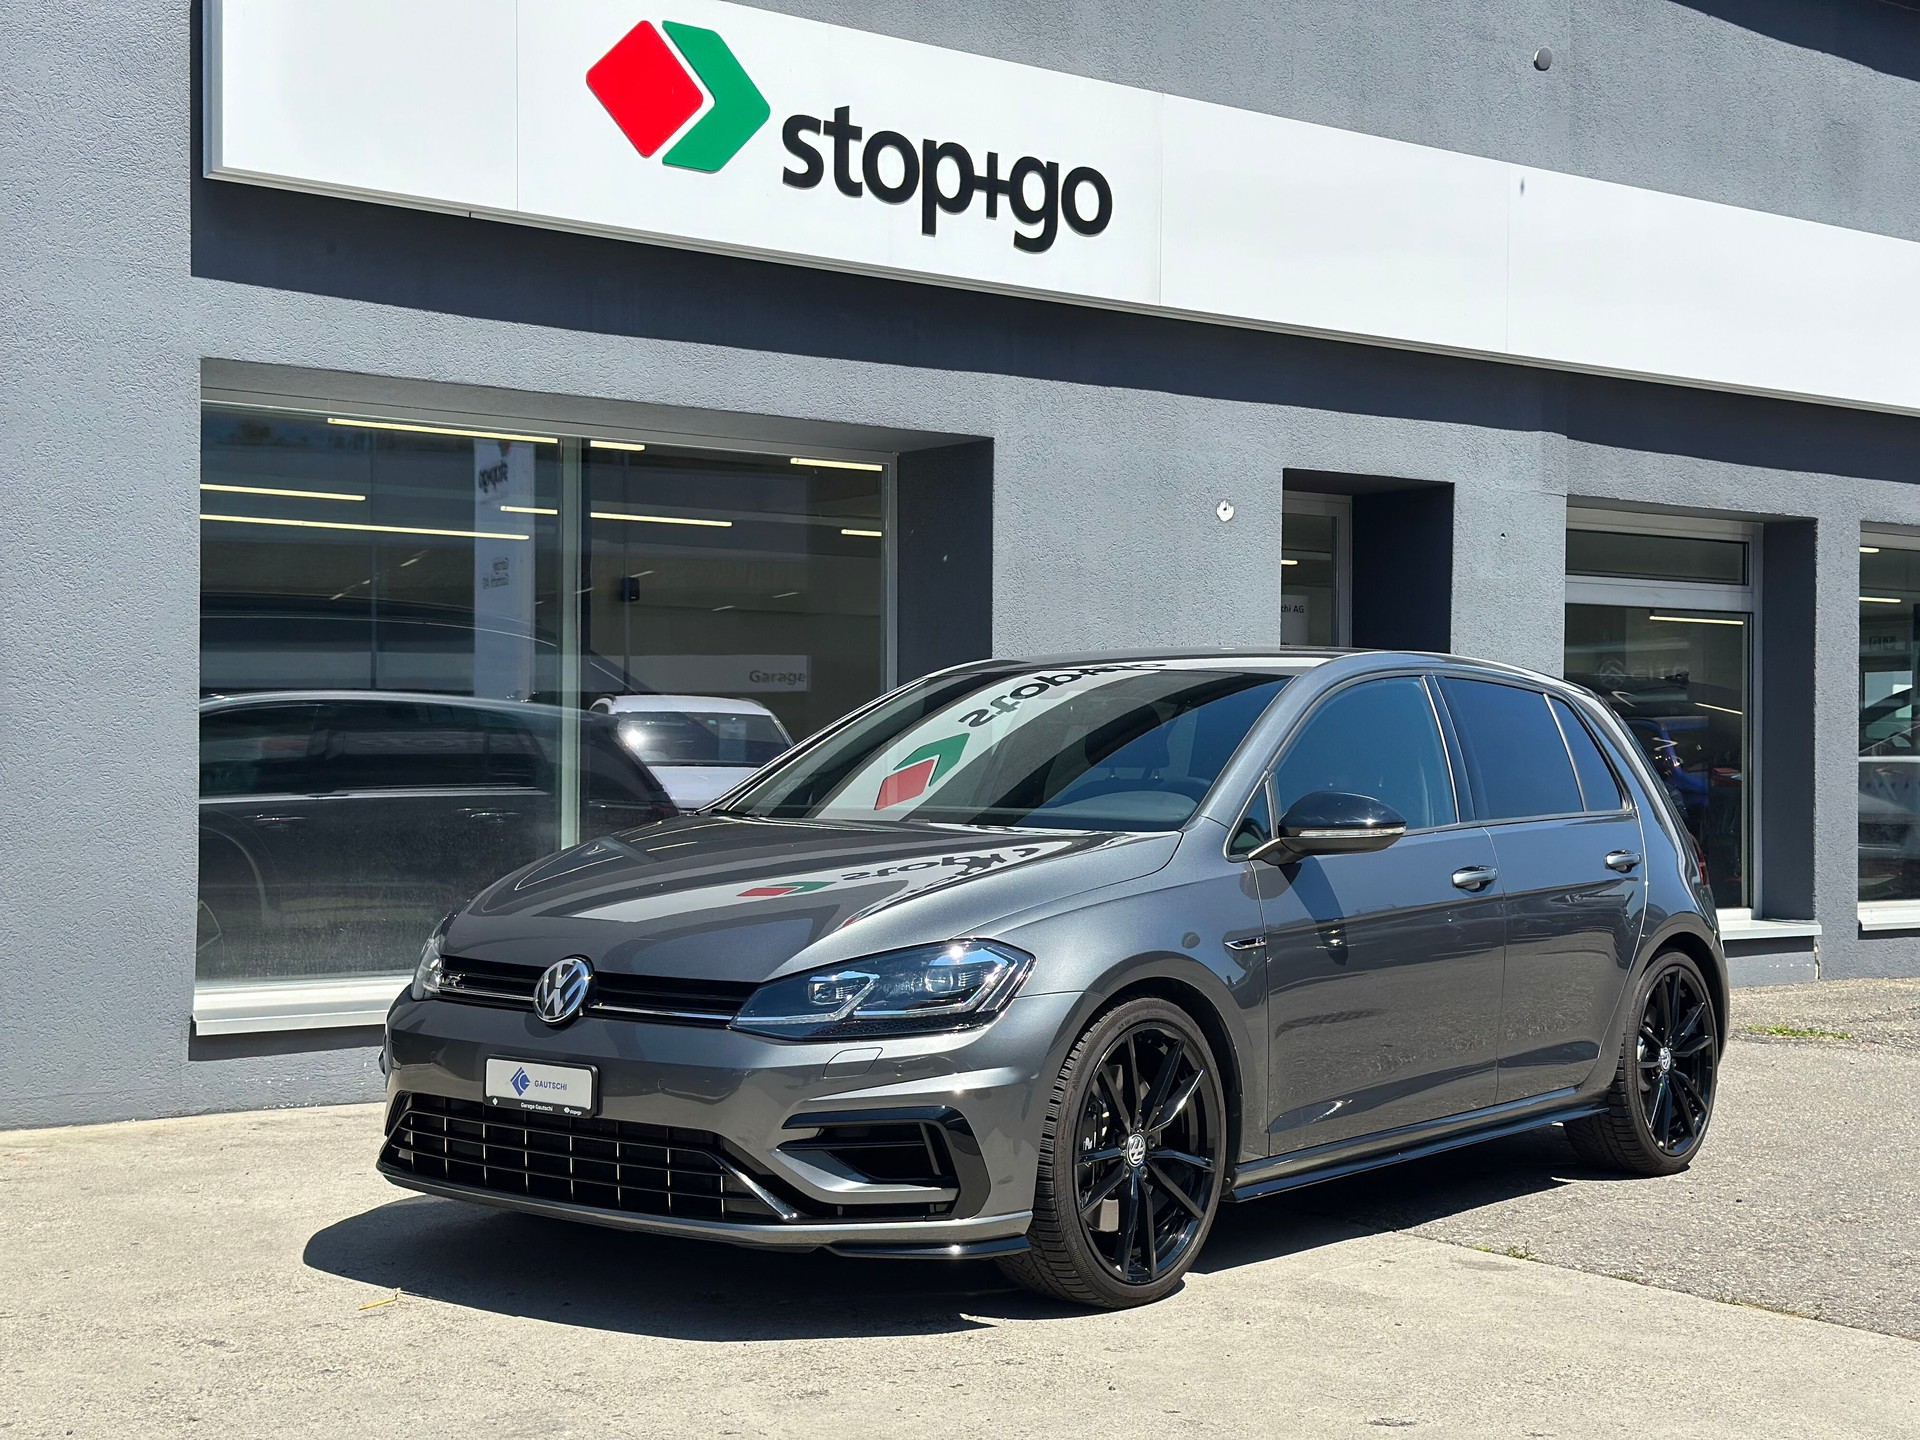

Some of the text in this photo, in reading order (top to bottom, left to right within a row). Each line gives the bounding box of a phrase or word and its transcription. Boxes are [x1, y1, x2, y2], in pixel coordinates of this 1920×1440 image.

[782, 105, 1113, 254] stop+go
[1293, 605, 1305, 614] AG
[749, 669, 807, 686] Garage
[534, 1079, 568, 1091] GAUTSCHI
